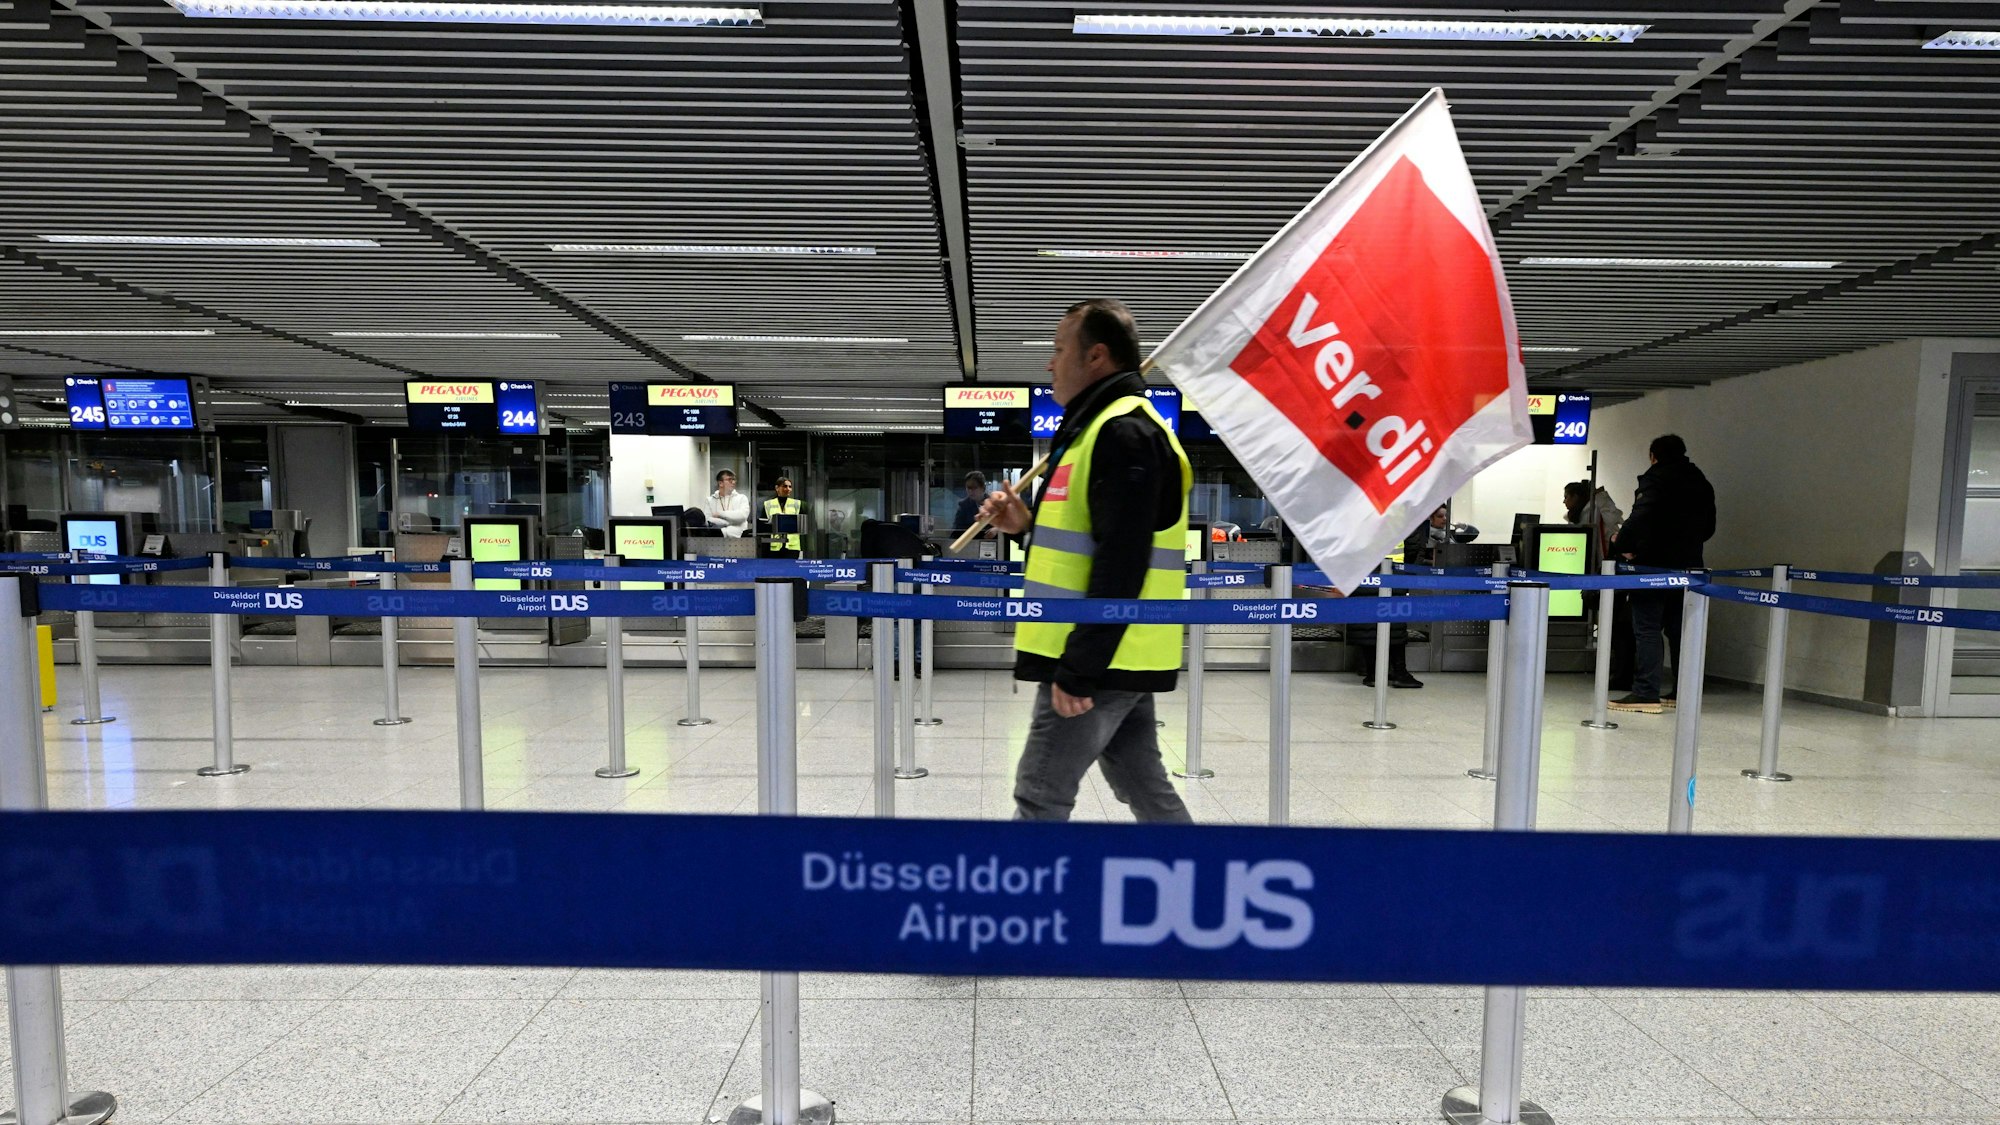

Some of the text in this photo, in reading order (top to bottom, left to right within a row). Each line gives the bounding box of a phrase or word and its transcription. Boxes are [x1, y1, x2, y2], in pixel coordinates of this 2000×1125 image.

[420, 386, 479, 396] PEGASUS
[660, 388, 718, 398] PEGASUS
[958, 390, 1015, 400] PEGASUS
[70, 406, 106, 422] 245
[502, 410, 536, 426] 244
[614, 412, 646, 427] 243
[1554, 422, 1586, 438] 240
[80, 536, 107, 546] DUS
[531, 567, 552, 576] DUS
[684, 570, 706, 580] DUS
[836, 569, 856, 578] DUS
[931, 573, 951, 584] DUS
[1225, 575, 1245, 584] DUS
[1668, 577, 1689, 586] DUS
[1904, 577, 1919, 585] DUS
[265, 592, 303, 609] DUS
[551, 595, 589, 611] DUS
[1760, 592, 1779, 604] DUS
[231, 600, 260, 609] Airport
[517, 603, 546, 612] Airport
[1006, 602, 1042, 617] DUS
[972, 608, 1001, 617] Airport
[1248, 612, 1276, 620] Airport
[1281, 603, 1317, 619] DUS
[1885, 607, 1915, 615] Düsseldorf
[1917, 609, 1943, 623] DUS
[802, 852, 1070, 893] Düsseldorf
[1101, 857, 1314, 950] DUS
[899, 902, 1068, 952] Airport
